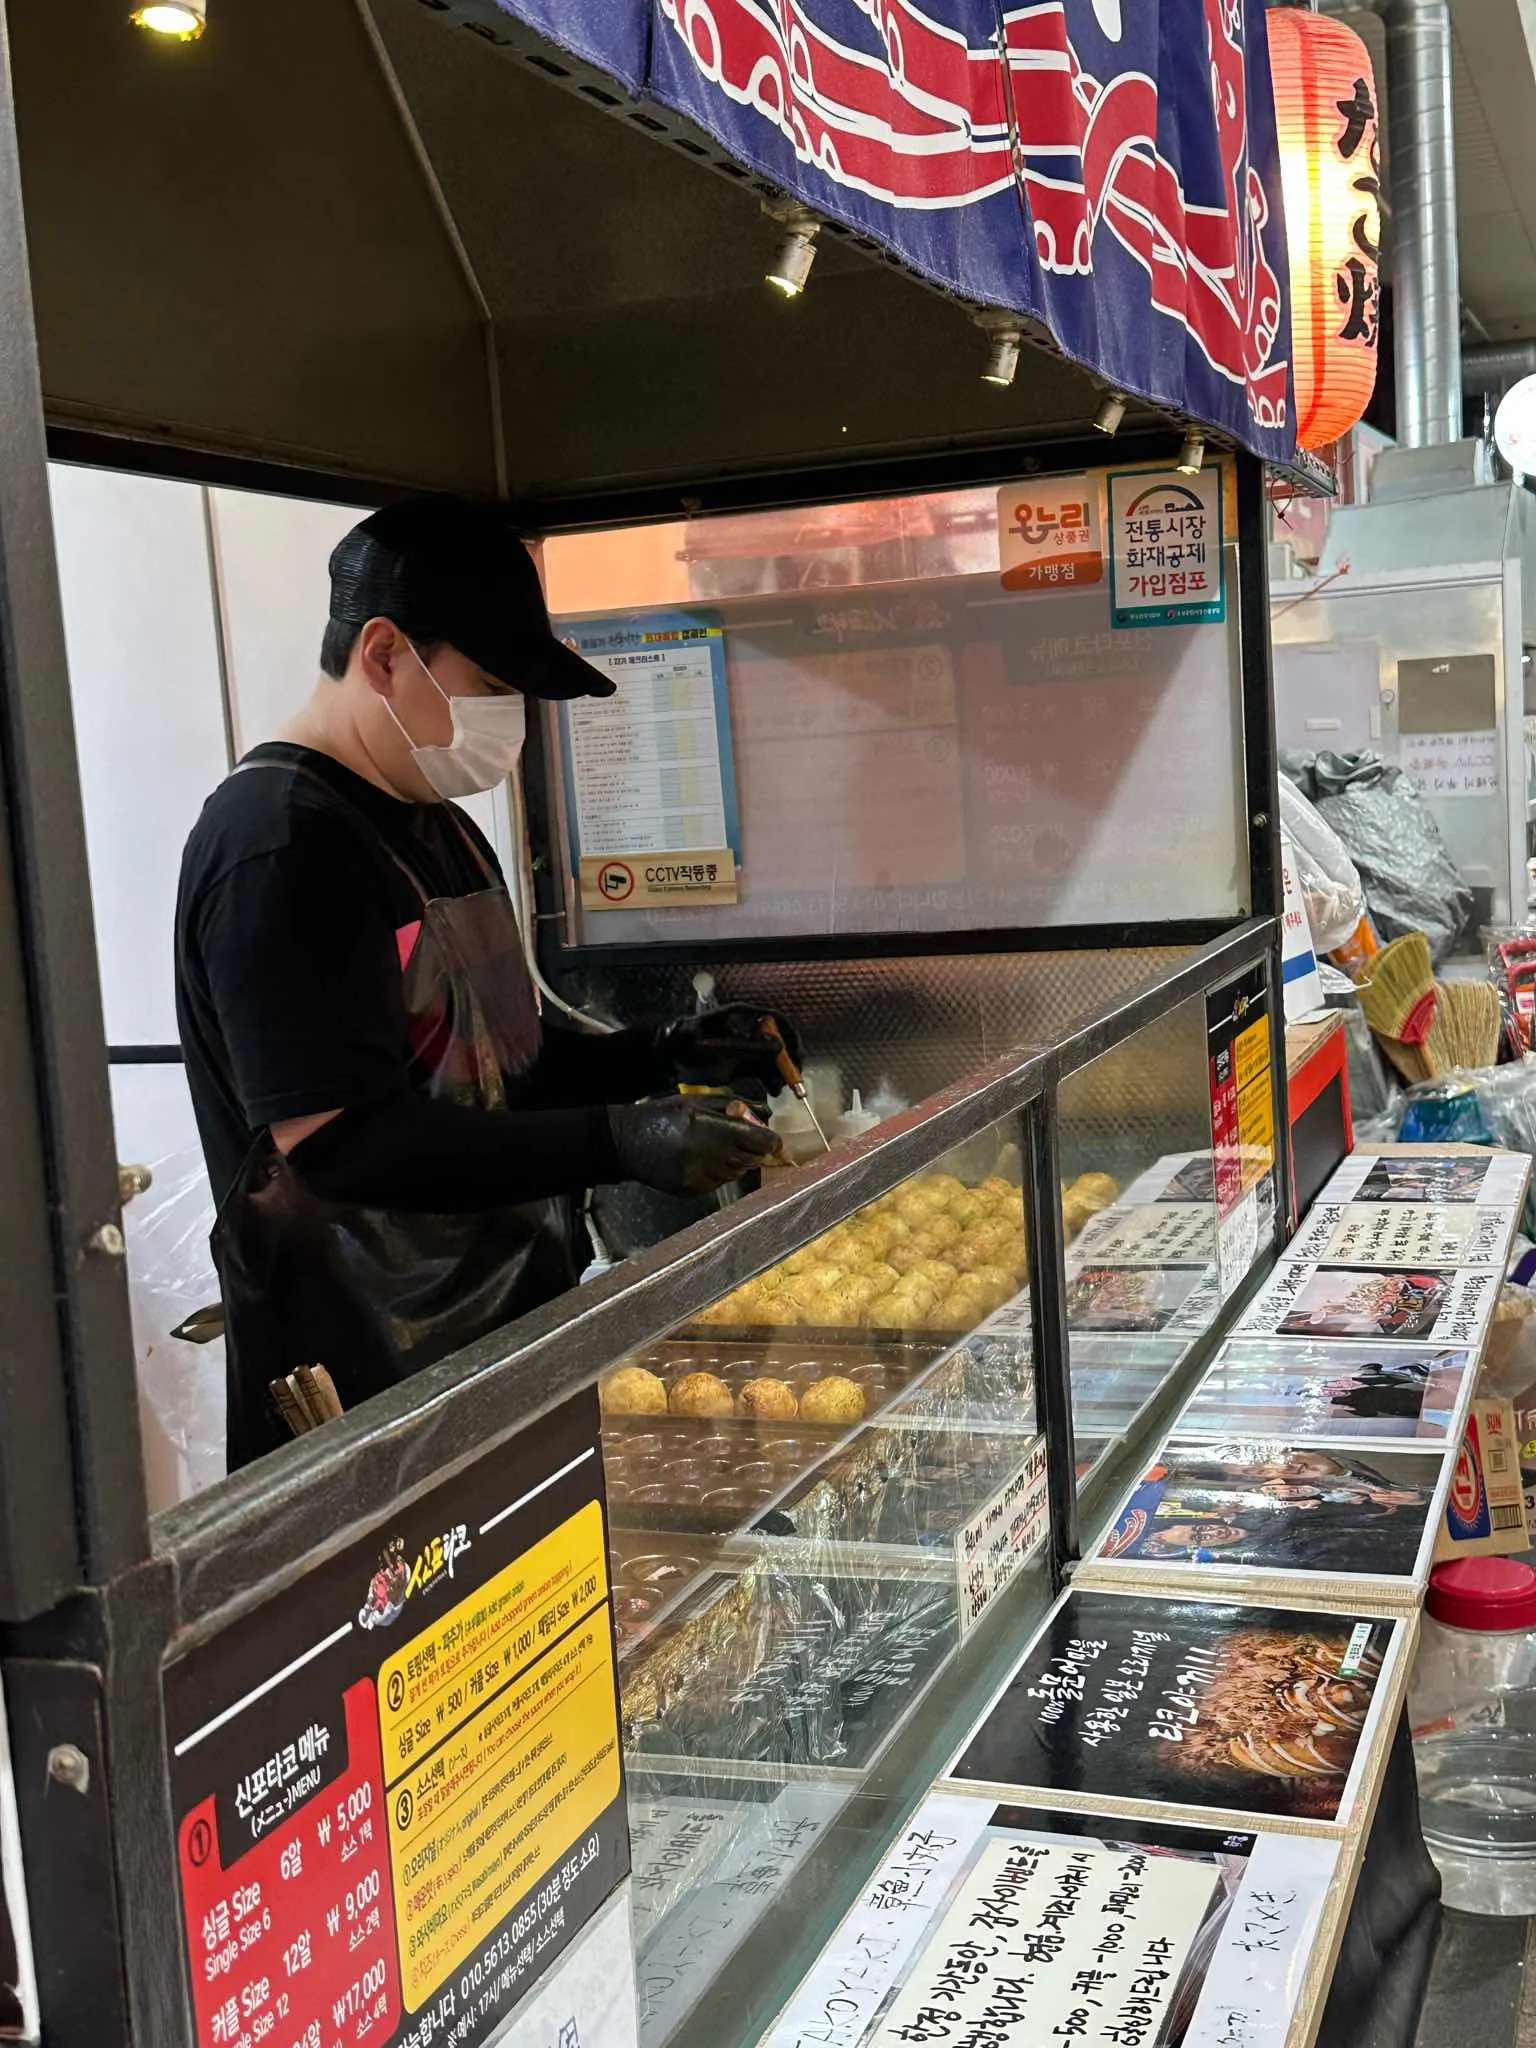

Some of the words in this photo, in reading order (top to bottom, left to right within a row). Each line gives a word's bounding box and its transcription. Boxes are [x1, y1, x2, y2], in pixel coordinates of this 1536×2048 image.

[1053, 529, 1090, 546] 상품권
[1125, 516, 1207, 543] 전통시장
[1030, 562, 1075, 582] 가맹점
[1127, 543, 1206, 569] 화재공제
[1129, 571, 1208, 598] 가입점포
[645, 864, 717, 882] CCTV작동중
[399, 1728, 414, 1758] 싱글
[415, 1719, 431, 1742] Size
[448, 1688, 462, 1714] 500
[485, 1661, 499, 1683] Size
[513, 1630, 531, 1659] 1,000
[579, 1576, 596, 1603] 2,000
[1118, 1630, 1170, 1676] 오리지널
[1103, 1680, 1144, 1702] 일본
[1149, 1648, 1230, 1741] 타코야끼!!
[1079, 1707, 1129, 1746] 사용한
[236, 1745, 298, 1817] 신포타코
[298, 1724, 330, 1762] 메뉴
[417, 1758, 445, 1800] 소스선택
[203, 1901, 230, 1950] 싱글
[232, 1883, 260, 1921] Size
[281, 1838, 302, 1880] 6알
[337, 1782, 371, 1831] 5,000
[341, 1835, 358, 1862] 소스
[561, 1856, 580, 1891] 정도
[580, 1833, 600, 1871] 소요)
[205, 1941, 238, 1981] Single
[240, 1921, 261, 1951] Size
[263, 1908, 271, 1930] 6
[349, 1924, 366, 1952] 소스
[366, 1907, 380, 1935] 2택
[889, 2007, 961, 2042] 한정
[970, 1846, 1049, 1929] 감사이벤트를
[212, 1997, 239, 2042] 커플
[242, 1978, 269, 2017] Size
[283, 1930, 311, 1976] 12알
[346, 1870, 380, 1920] 9,000
[253, 2012, 274, 2042] Size
[276, 1993, 290, 2018] 12
[357, 2011, 373, 2040] 소스
